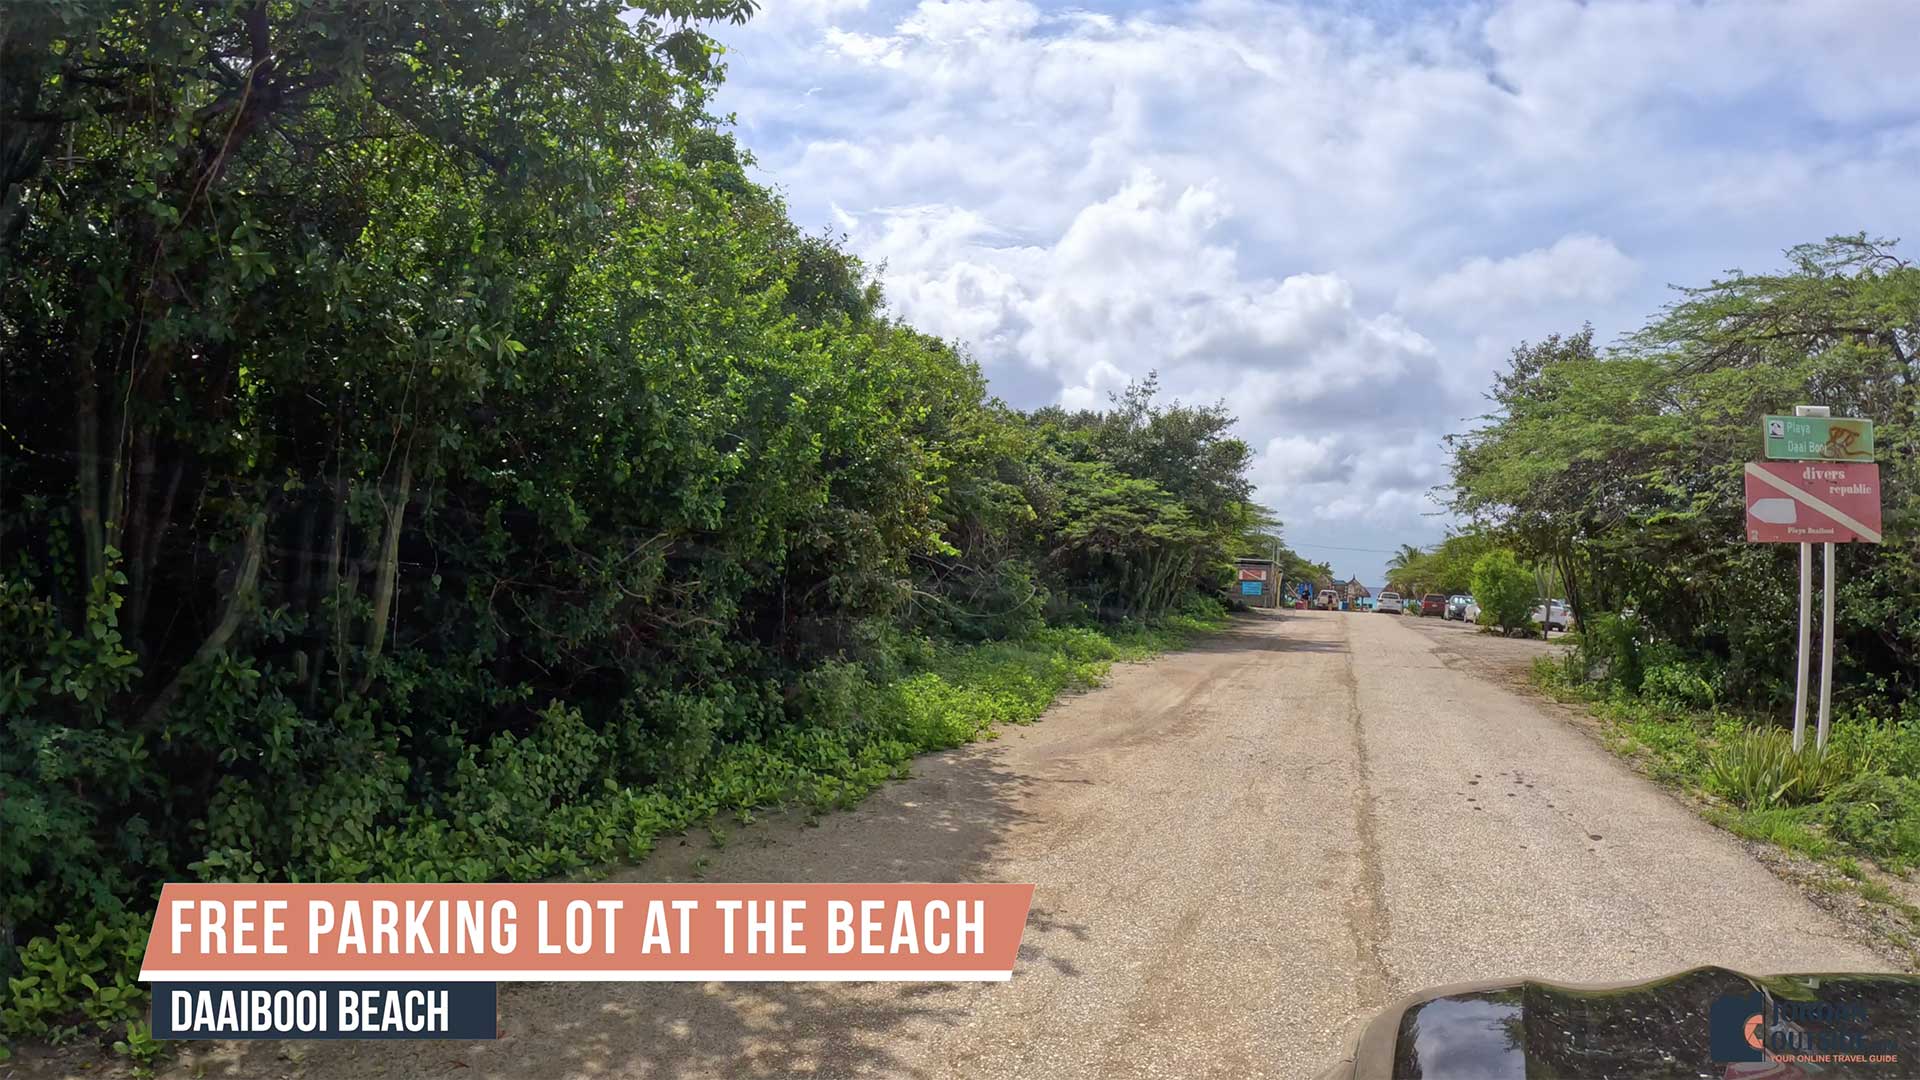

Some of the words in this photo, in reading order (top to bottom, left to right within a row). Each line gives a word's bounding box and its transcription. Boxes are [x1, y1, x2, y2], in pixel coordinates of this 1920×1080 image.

[1786, 421, 1811, 437] Playa
[1802, 466, 1846, 480] divers
[1829, 483, 1872, 497] republic
